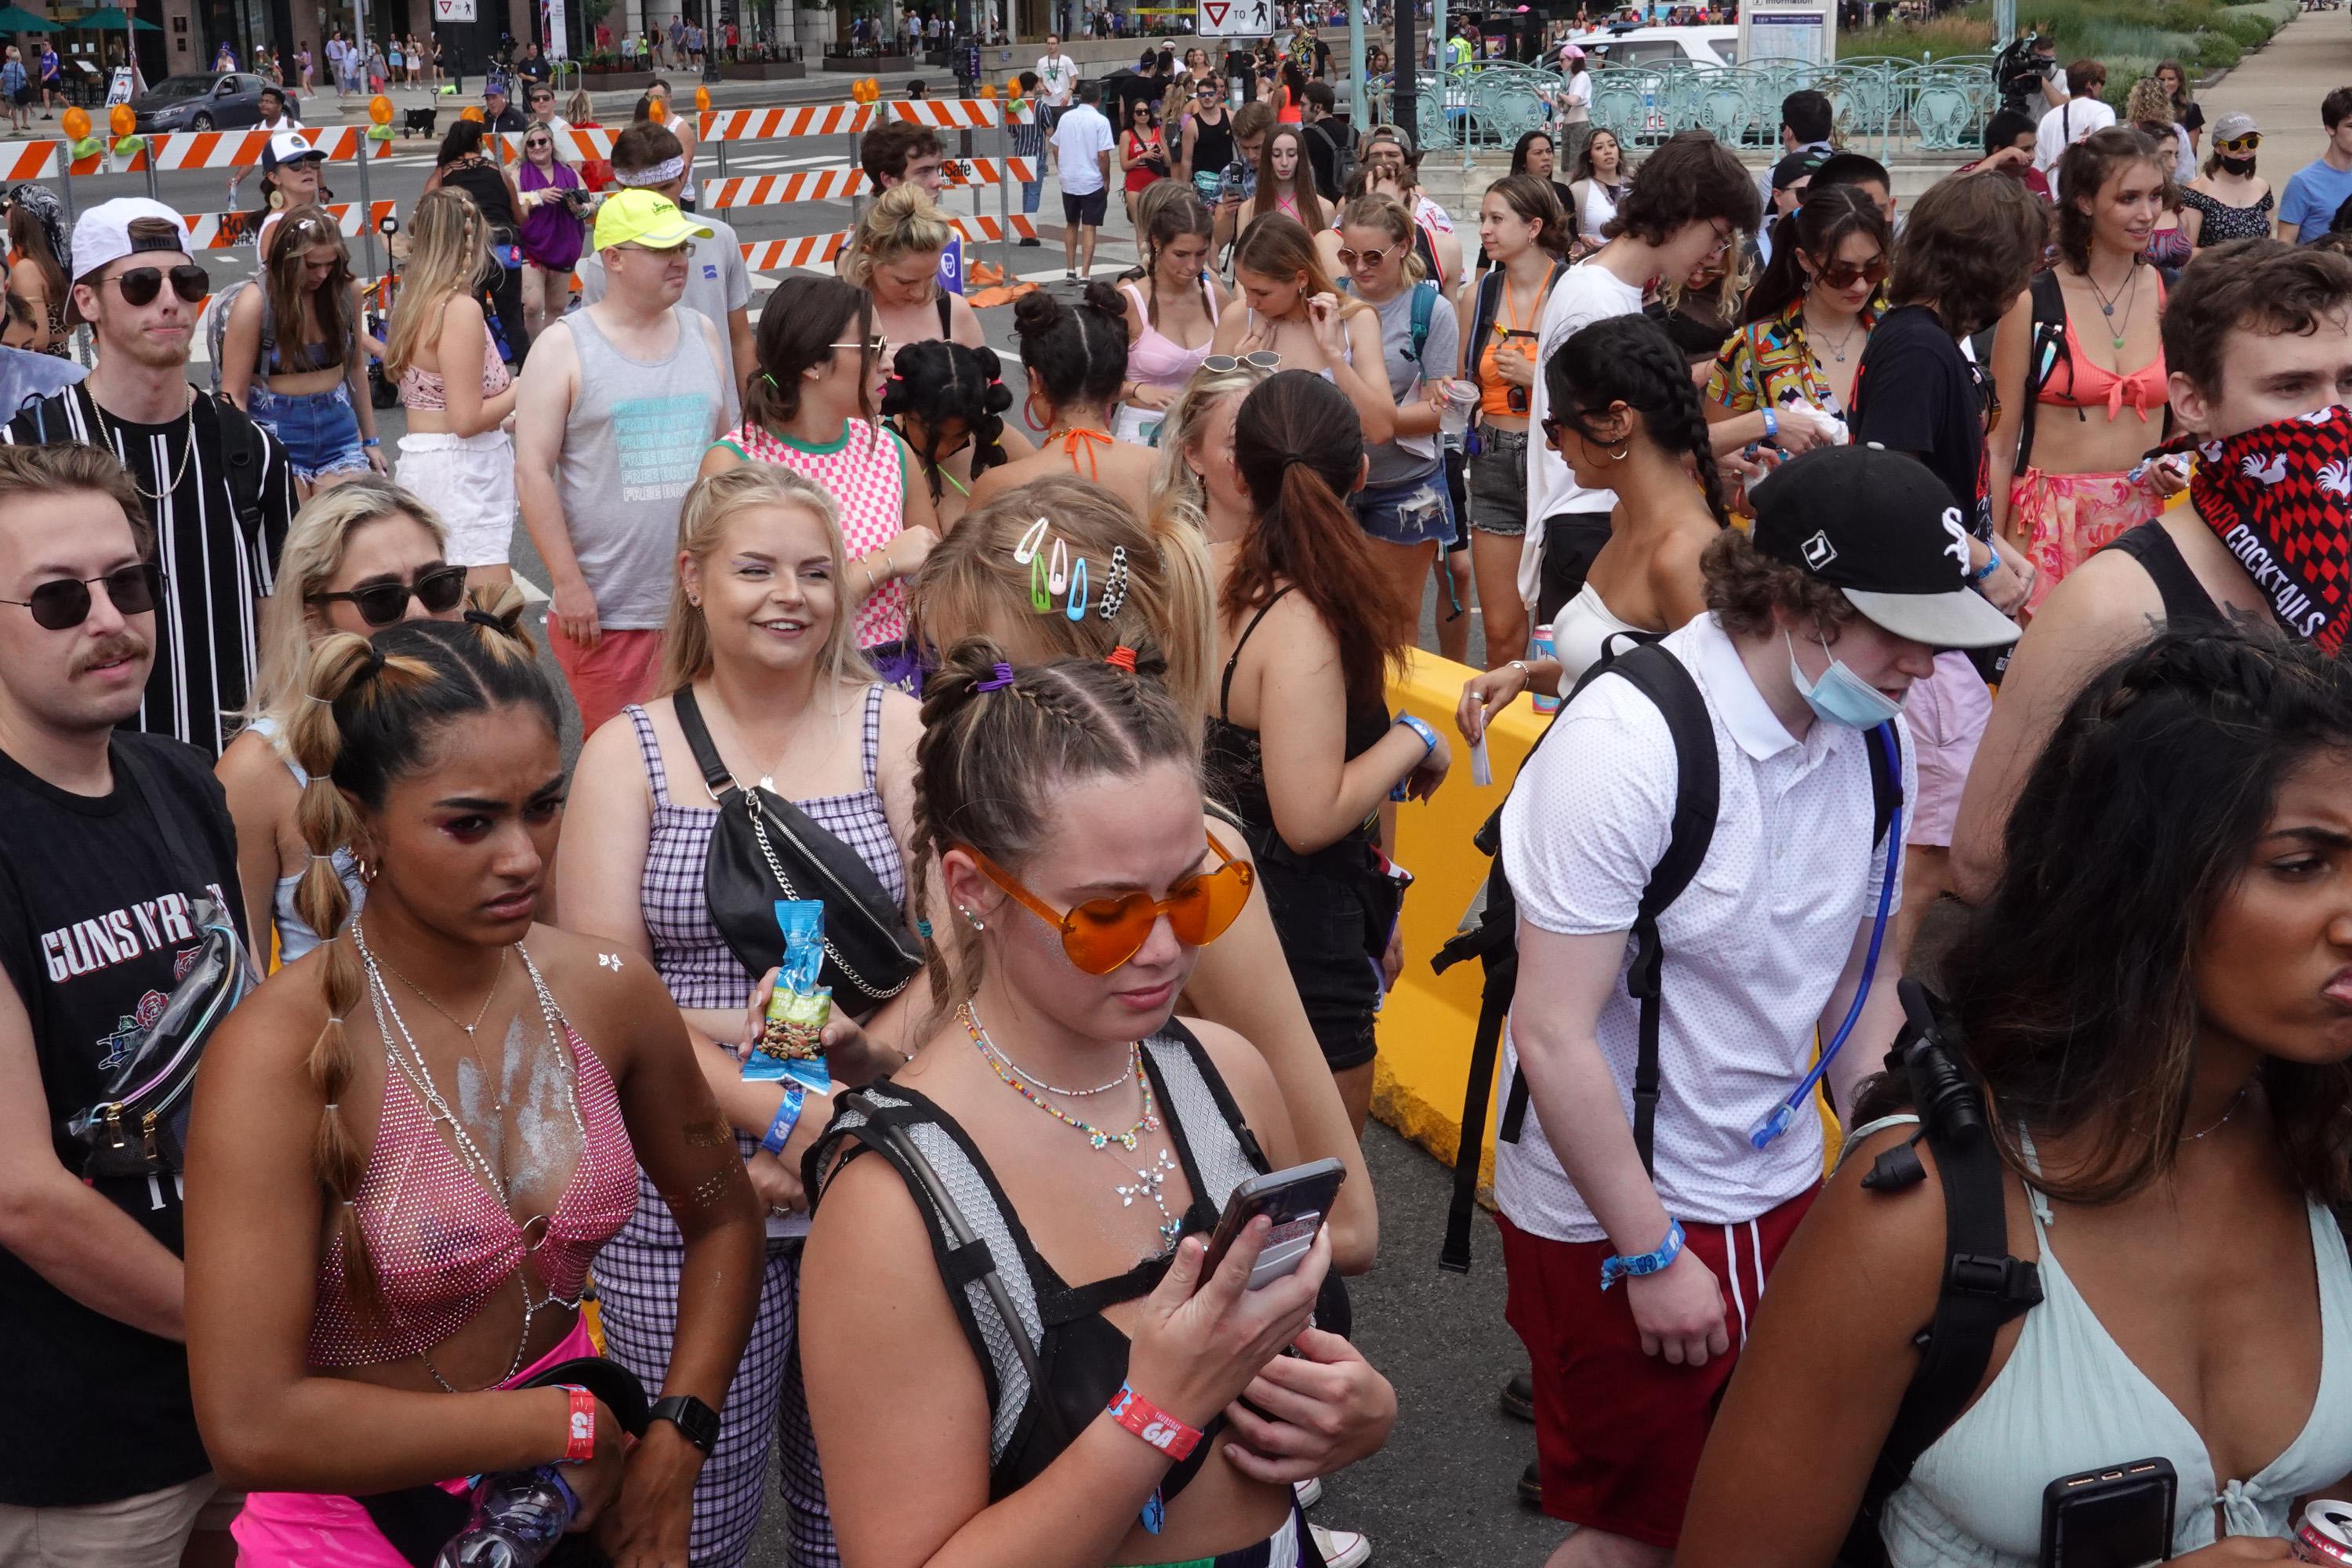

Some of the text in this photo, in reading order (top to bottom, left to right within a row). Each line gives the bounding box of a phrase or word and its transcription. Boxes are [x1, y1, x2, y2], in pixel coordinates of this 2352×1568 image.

[1233, 10, 1246, 19] TO
[937, 159, 971, 177] dSafe
[615, 417, 652, 433] FREE
[617, 434, 654, 450] FREE
[619, 451, 659, 467] FREE
[621, 468, 659, 485] FREE
[623, 486, 661, 502] FREE
[2225, 523, 2326, 637] COCKTAILS
[42, 909, 143, 983] GUNS
[572, 1411, 588, 1439] GA
[1154, 1411, 1182, 1432] THURSDAY
[1142, 1421, 1177, 1449] GA
[2323, 1543, 2338, 1556] OZ
